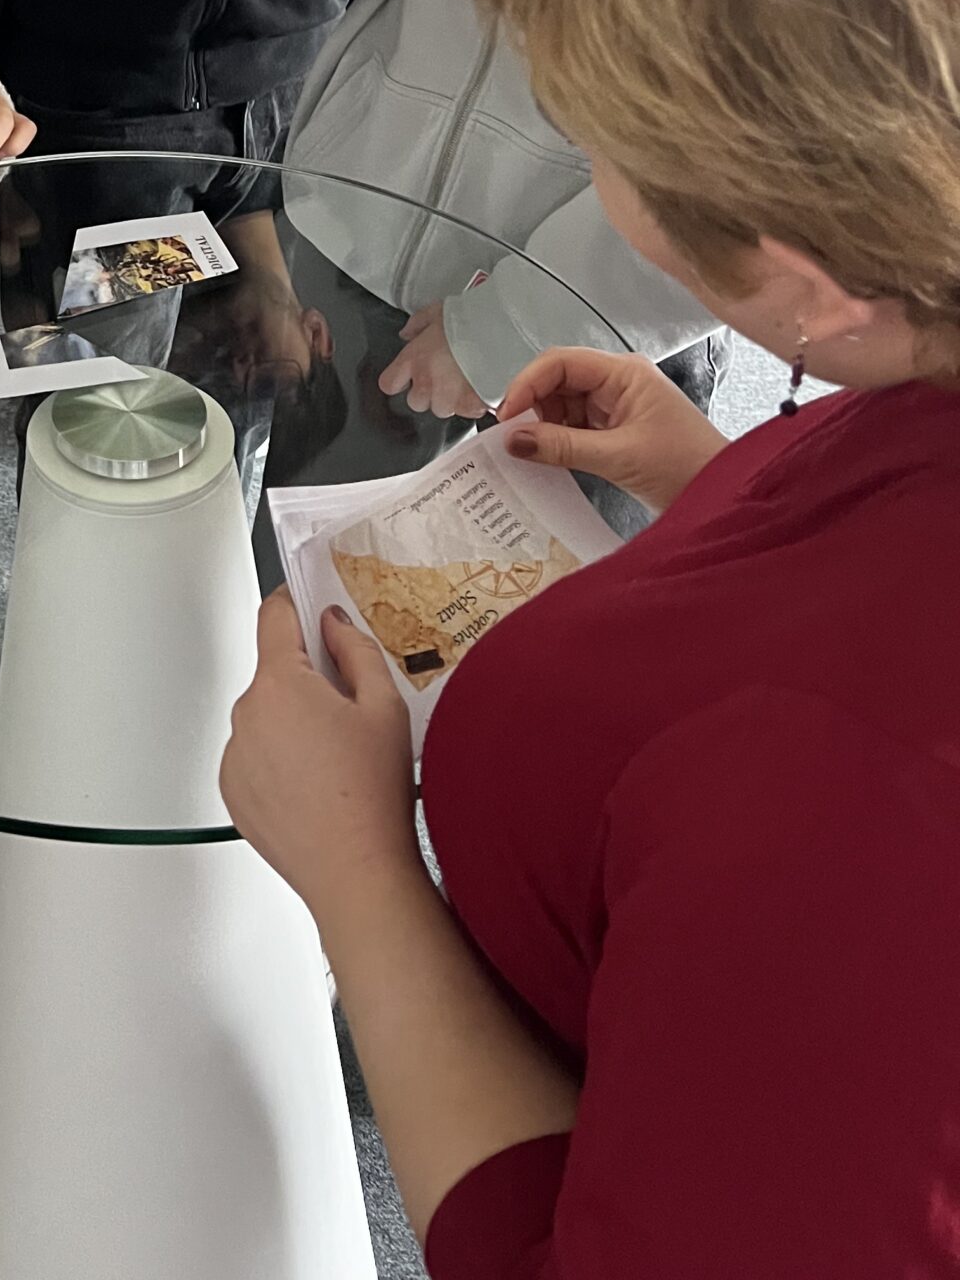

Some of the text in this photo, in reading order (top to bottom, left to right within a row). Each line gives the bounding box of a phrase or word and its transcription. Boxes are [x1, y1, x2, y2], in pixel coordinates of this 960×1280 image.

[195, 235, 223, 270] DIGITAL
[436, 590, 477, 624] Schatz
[453, 609, 499, 647] Goethes
